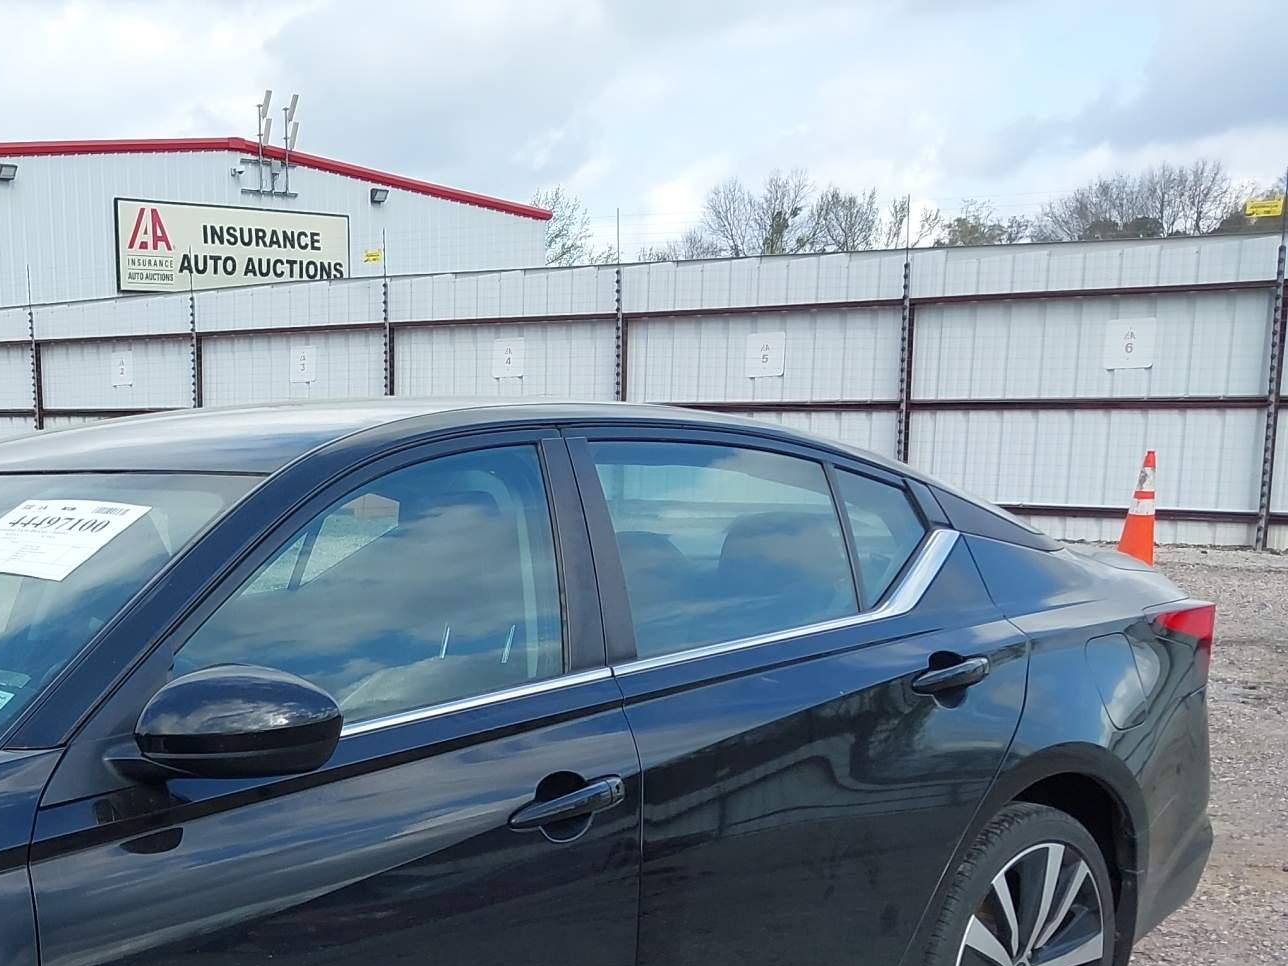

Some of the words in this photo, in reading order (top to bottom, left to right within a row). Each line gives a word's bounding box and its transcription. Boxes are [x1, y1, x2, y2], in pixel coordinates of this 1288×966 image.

[202, 224, 321, 251] INSURANCE
[127, 258, 173, 268] INSURANCE
[178, 253, 237, 276] AUTO
[243, 256, 344, 280] AUCTIONS
[127, 272, 144, 280] AUTO
[144, 272, 174, 281] AUCTIONS
[9, 515, 110, 533] 44497100
